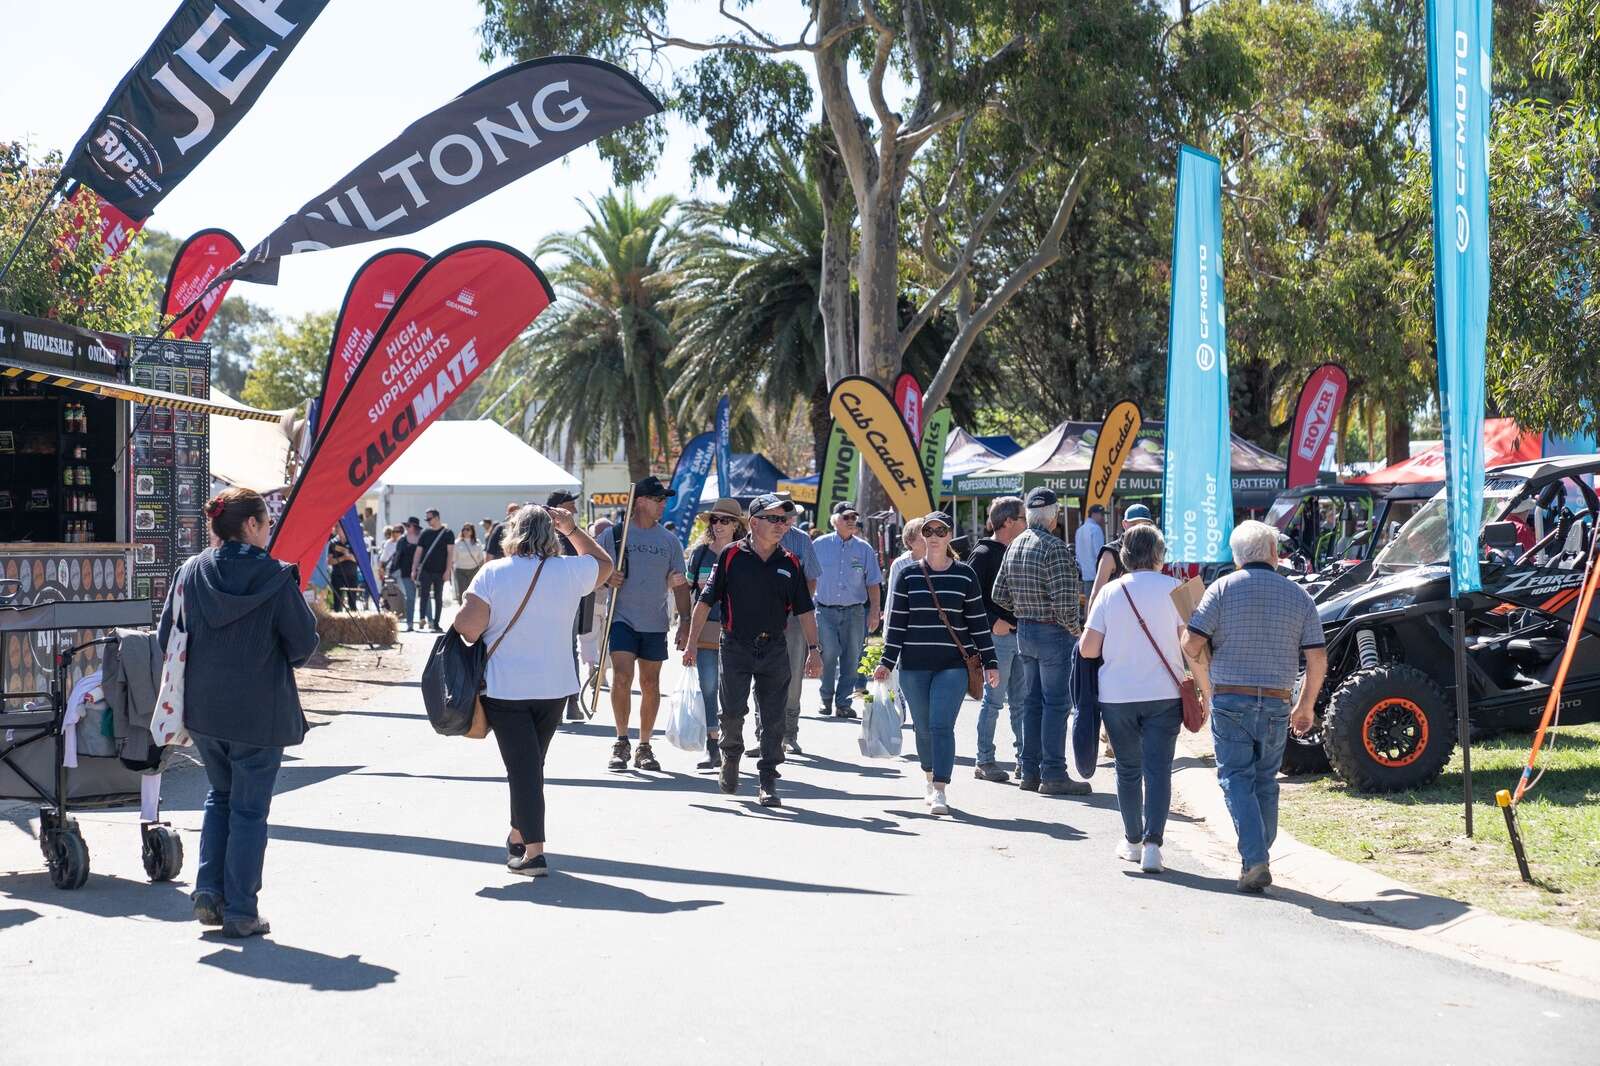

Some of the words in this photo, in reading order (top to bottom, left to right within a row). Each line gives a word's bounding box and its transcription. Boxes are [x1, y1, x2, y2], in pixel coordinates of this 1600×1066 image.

[1455, 30, 1469, 196] CFMOTO
[97, 129, 139, 172] RJB
[1199, 244, 1209, 340] CFMOTO
[23, 331, 74, 357] WHOLESALE
[341, 327, 362, 363] HIGH
[381, 328, 434, 386] CALCIUM
[386, 321, 419, 360] HIGH
[368, 333, 451, 424] SUPPLEMENTS
[348, 340, 480, 487] CALCIMATE
[839, 392, 874, 430] Cub
[866, 431, 917, 492] Cadet
[1303, 390, 1333, 451] ROVER
[1044, 478, 1067, 489] THE
[1232, 478, 1280, 489] BATTERY
[1094, 466, 1112, 499] Cub
[1108, 410, 1135, 464] Cadet
[1183, 509, 1197, 562] more
[1201, 472, 1222, 562] together
[1531, 587, 1560, 596] 1000
[1528, 699, 1582, 715] CFOTO
